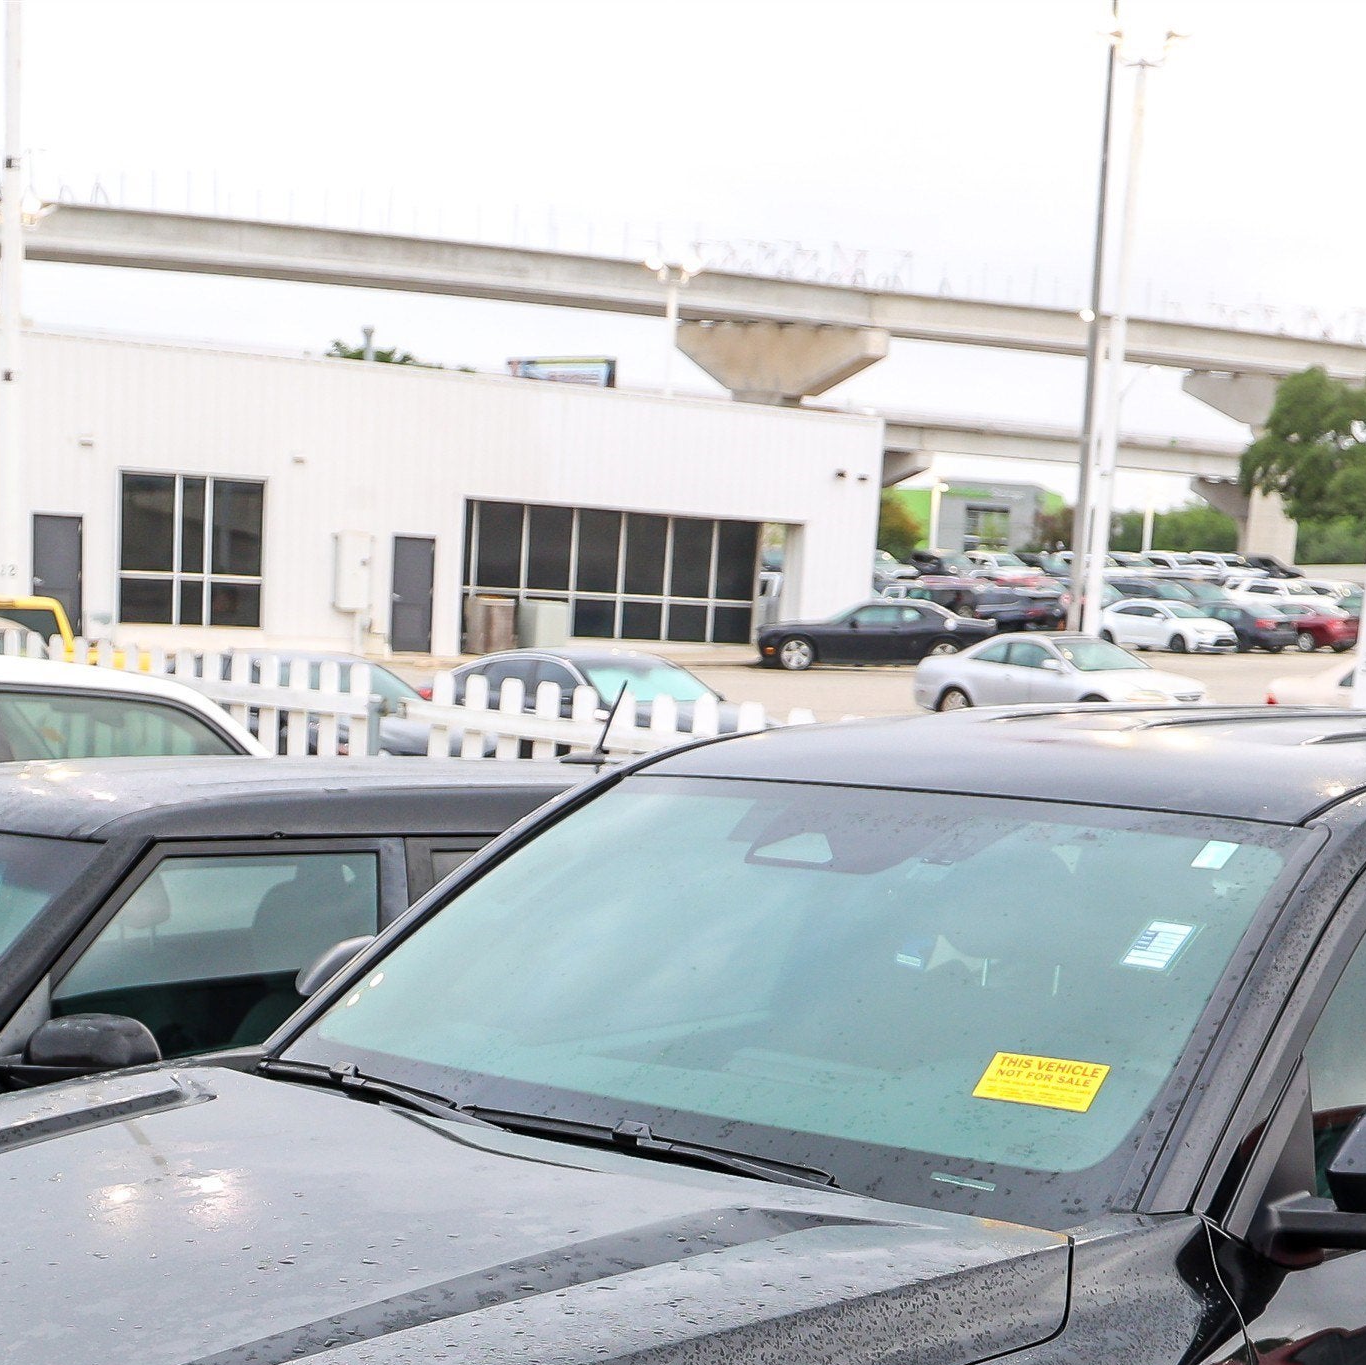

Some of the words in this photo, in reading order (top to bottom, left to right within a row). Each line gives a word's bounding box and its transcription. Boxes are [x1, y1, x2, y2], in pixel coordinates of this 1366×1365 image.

[998, 1056, 1033, 1068] THIS
[1037, 1061, 1102, 1078] VEHICLE
[996, 1069, 1023, 1078] NOT
[1026, 1072, 1053, 1082] FOR
[1057, 1076, 1091, 1088] SALE
